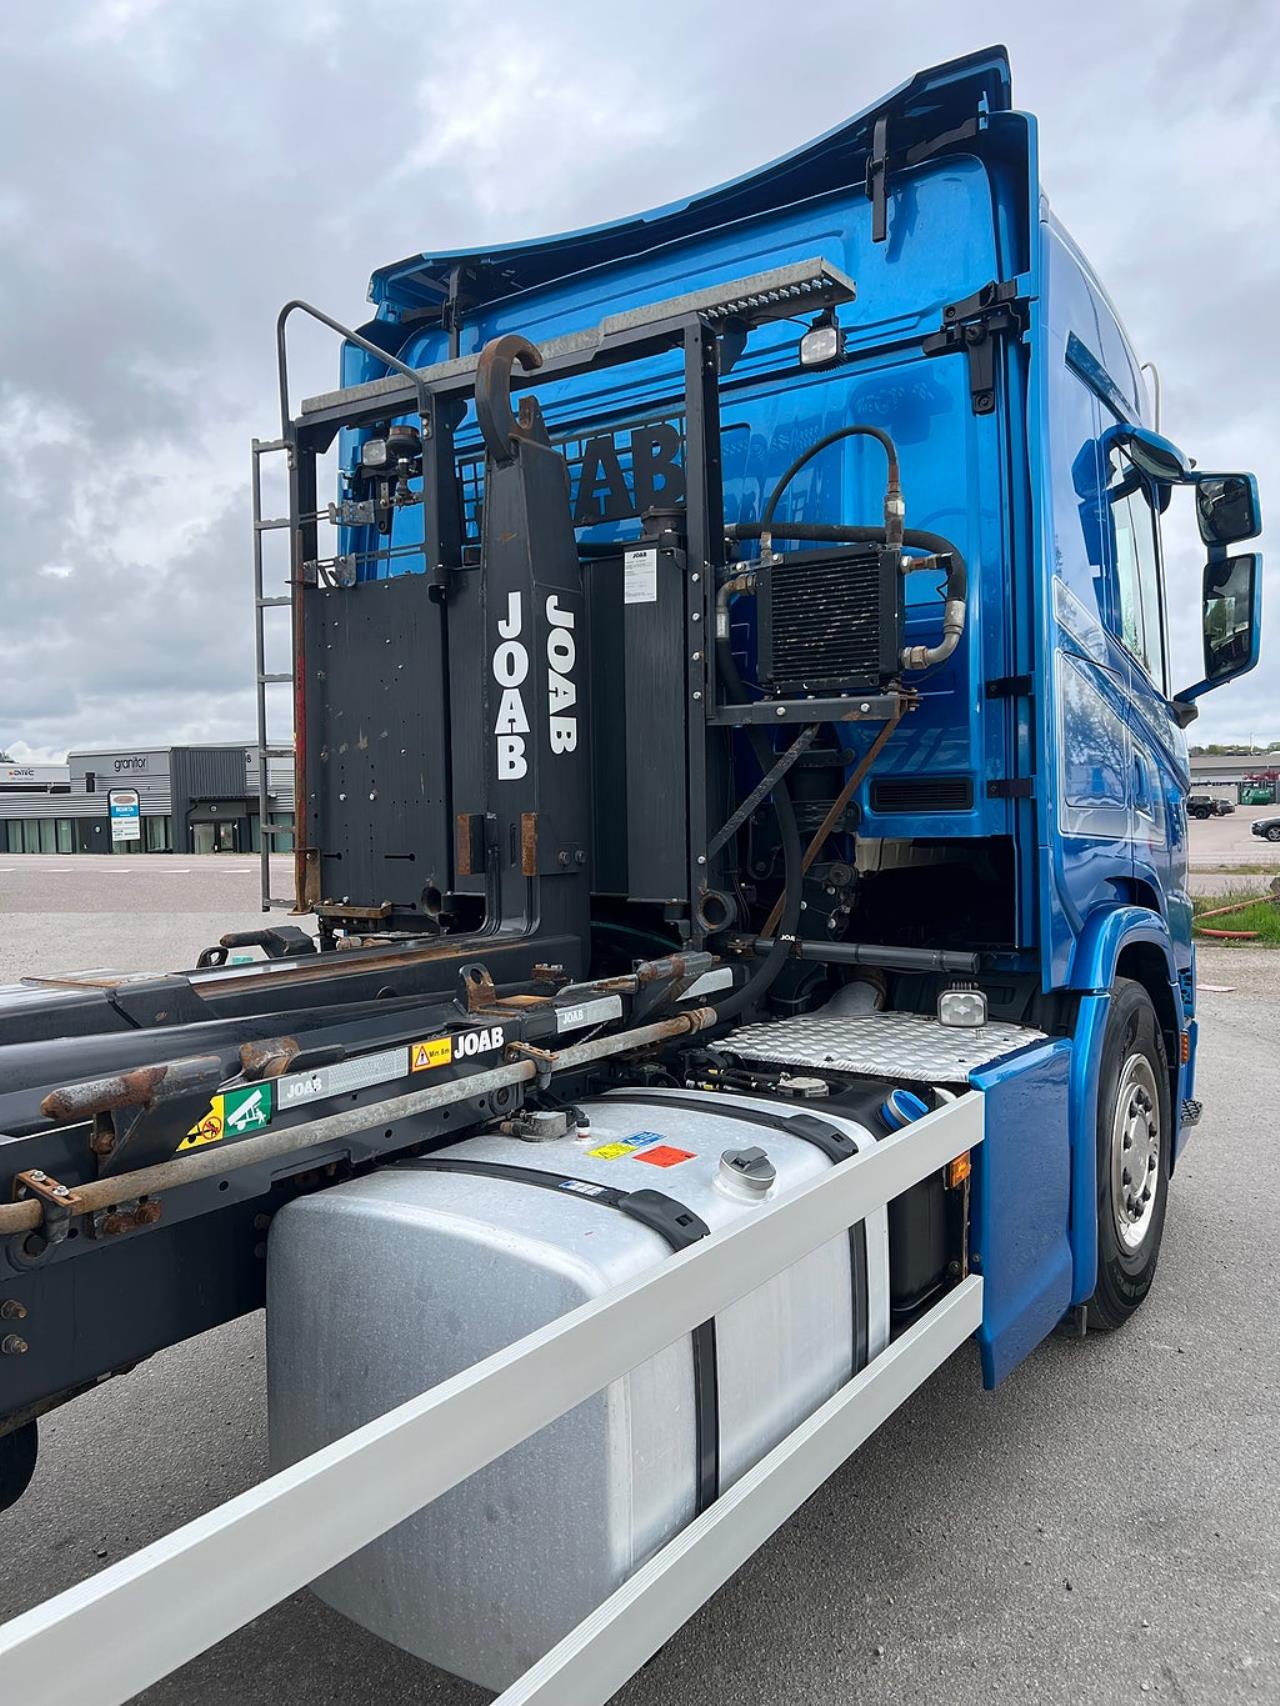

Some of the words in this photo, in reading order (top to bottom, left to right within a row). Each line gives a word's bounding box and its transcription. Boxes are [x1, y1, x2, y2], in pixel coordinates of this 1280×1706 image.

[573, 424, 687, 525] AB
[493, 592, 530, 780] JOAB
[546, 595, 577, 755] JOAB
[454, 1026, 505, 1059] JOAB
[562, 1009, 584, 1025] JOAB
[287, 1078, 322, 1098] JOAB
